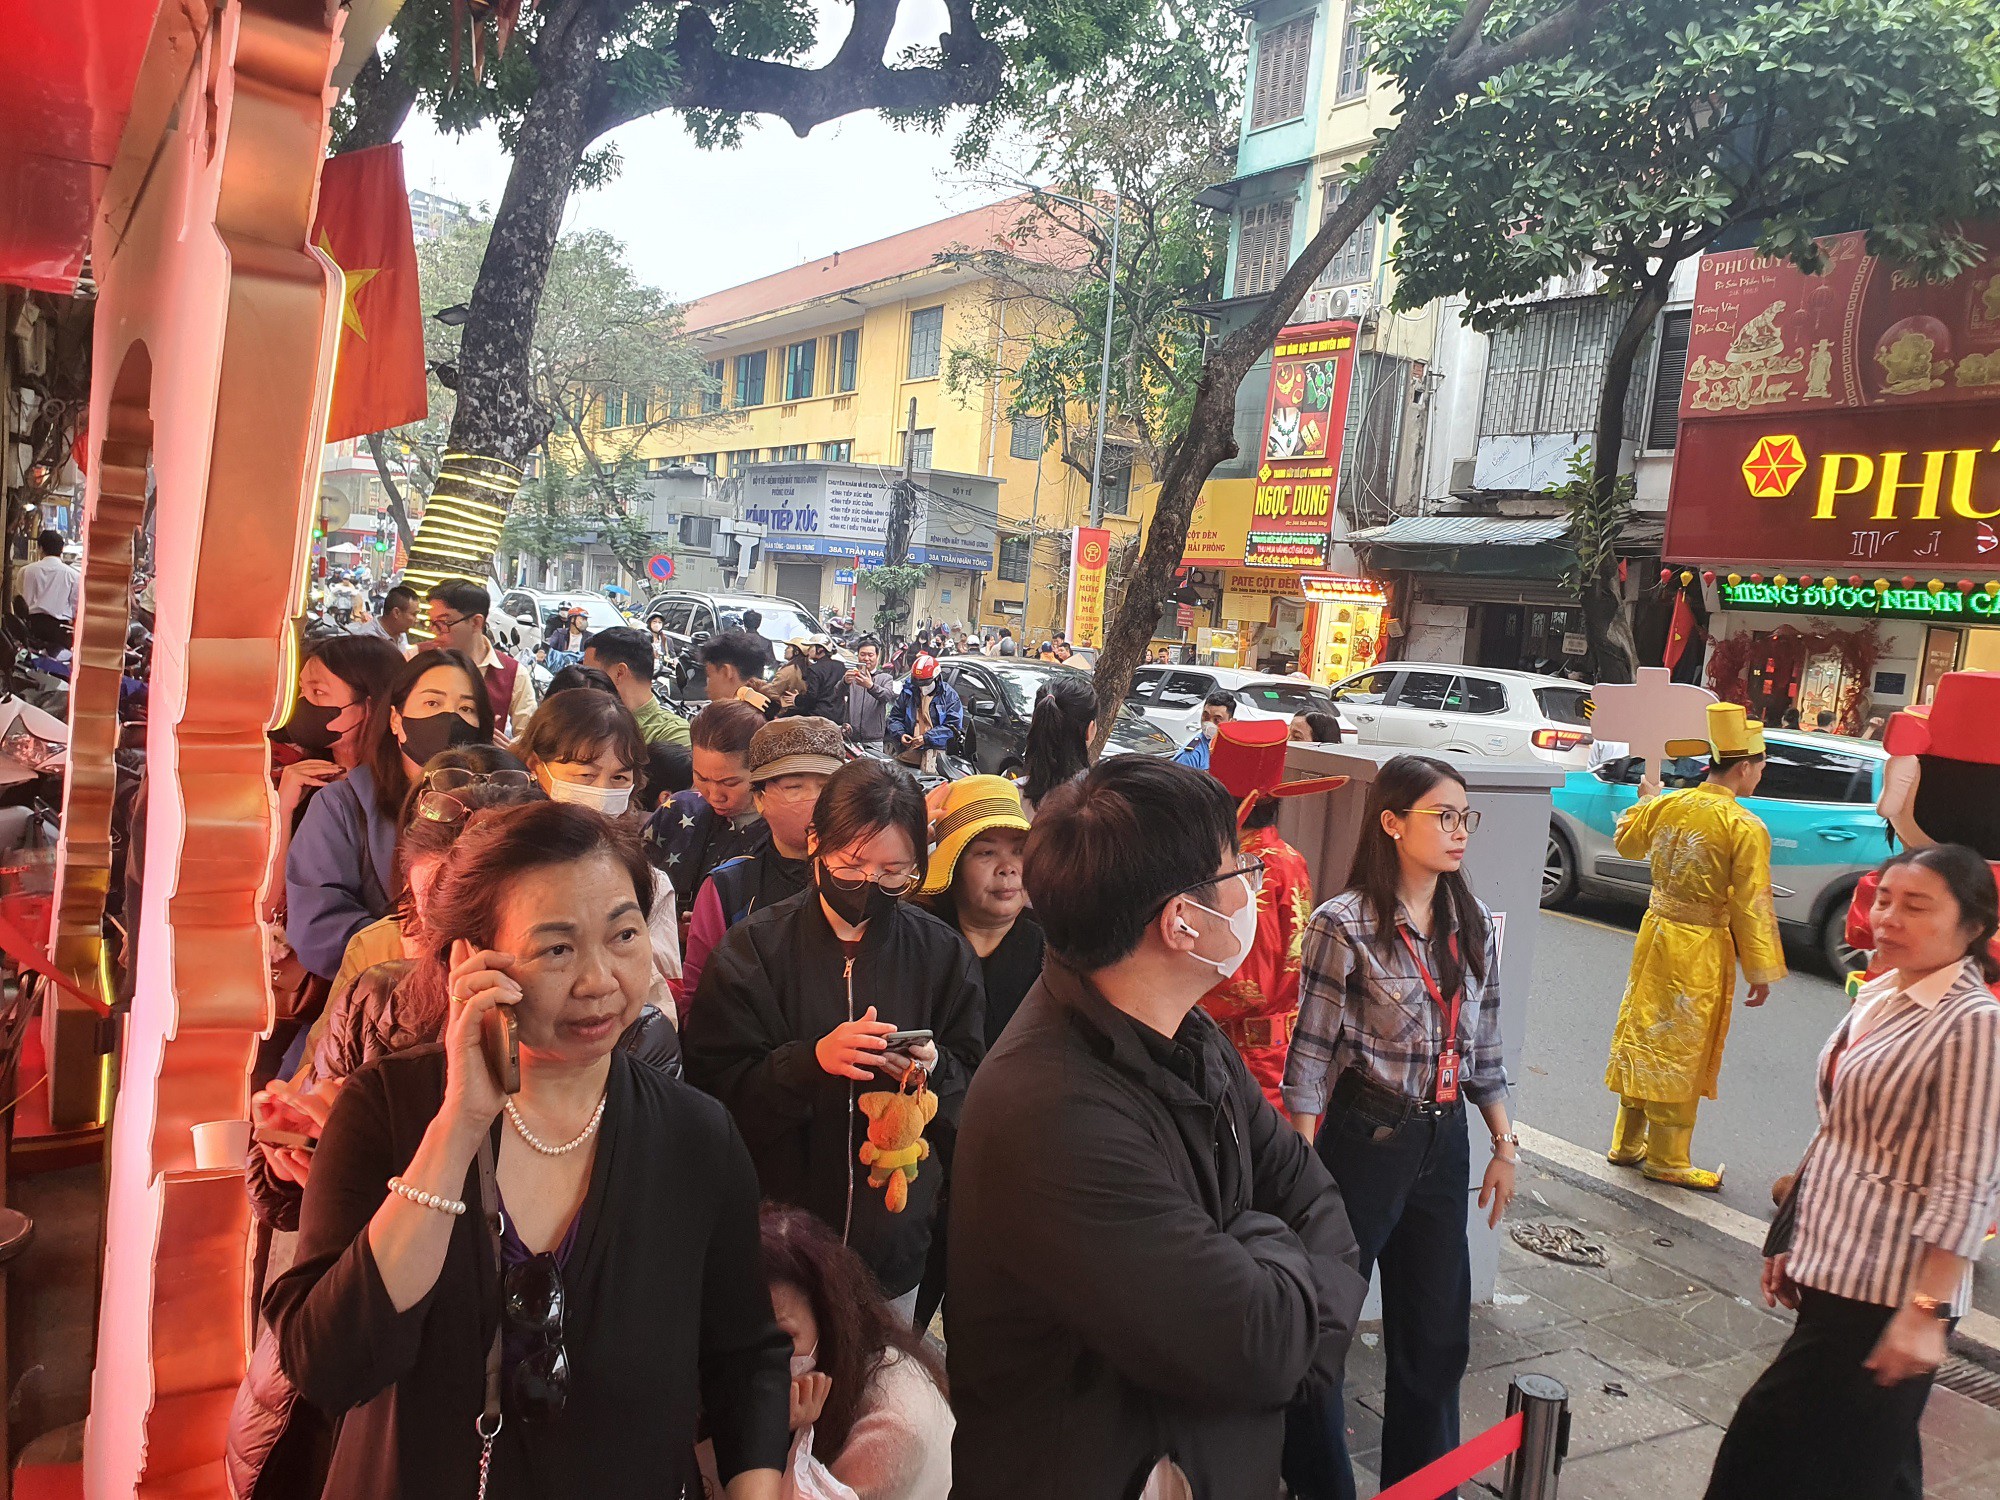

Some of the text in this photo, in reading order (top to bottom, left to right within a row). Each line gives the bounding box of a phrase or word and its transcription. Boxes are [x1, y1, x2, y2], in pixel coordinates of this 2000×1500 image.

[1714, 256, 1748, 276] PHÚ
[1721, 301, 1740, 319] Vàng
[1811, 439, 2000, 520] PHÚ
[772, 486, 783, 496] PHÒNG
[1254, 485, 1332, 520] NGỌC DUNG
[771, 500, 793, 532] TIẾP
[795, 504, 818, 532] XÚC
[1187, 530, 1200, 540] CỘT
[930, 535, 940, 543] BỆNH
[941, 536, 951, 544] VIỆN
[976, 540, 988, 548] ƯƠNG
[1188, 542, 1226, 552] HẢI PHÒNG
[828, 546, 842, 554] 38A
[845, 546, 866, 556] TRẦN
[941, 554, 956, 563] TRẦN
[957, 556, 971, 565] NHÂN
[972, 556, 987, 566] TÔNG
[1080, 574, 1100, 583] CHÚC
[1232, 576, 1300, 589] PATE CỘT ĐÈN
[1079, 584, 1099, 592] MỪNG
[1081, 594, 1096, 603] NĂM
[1802, 584, 1876, 610] ĐƯỢC
[1880, 590, 1963, 612] NHNN
